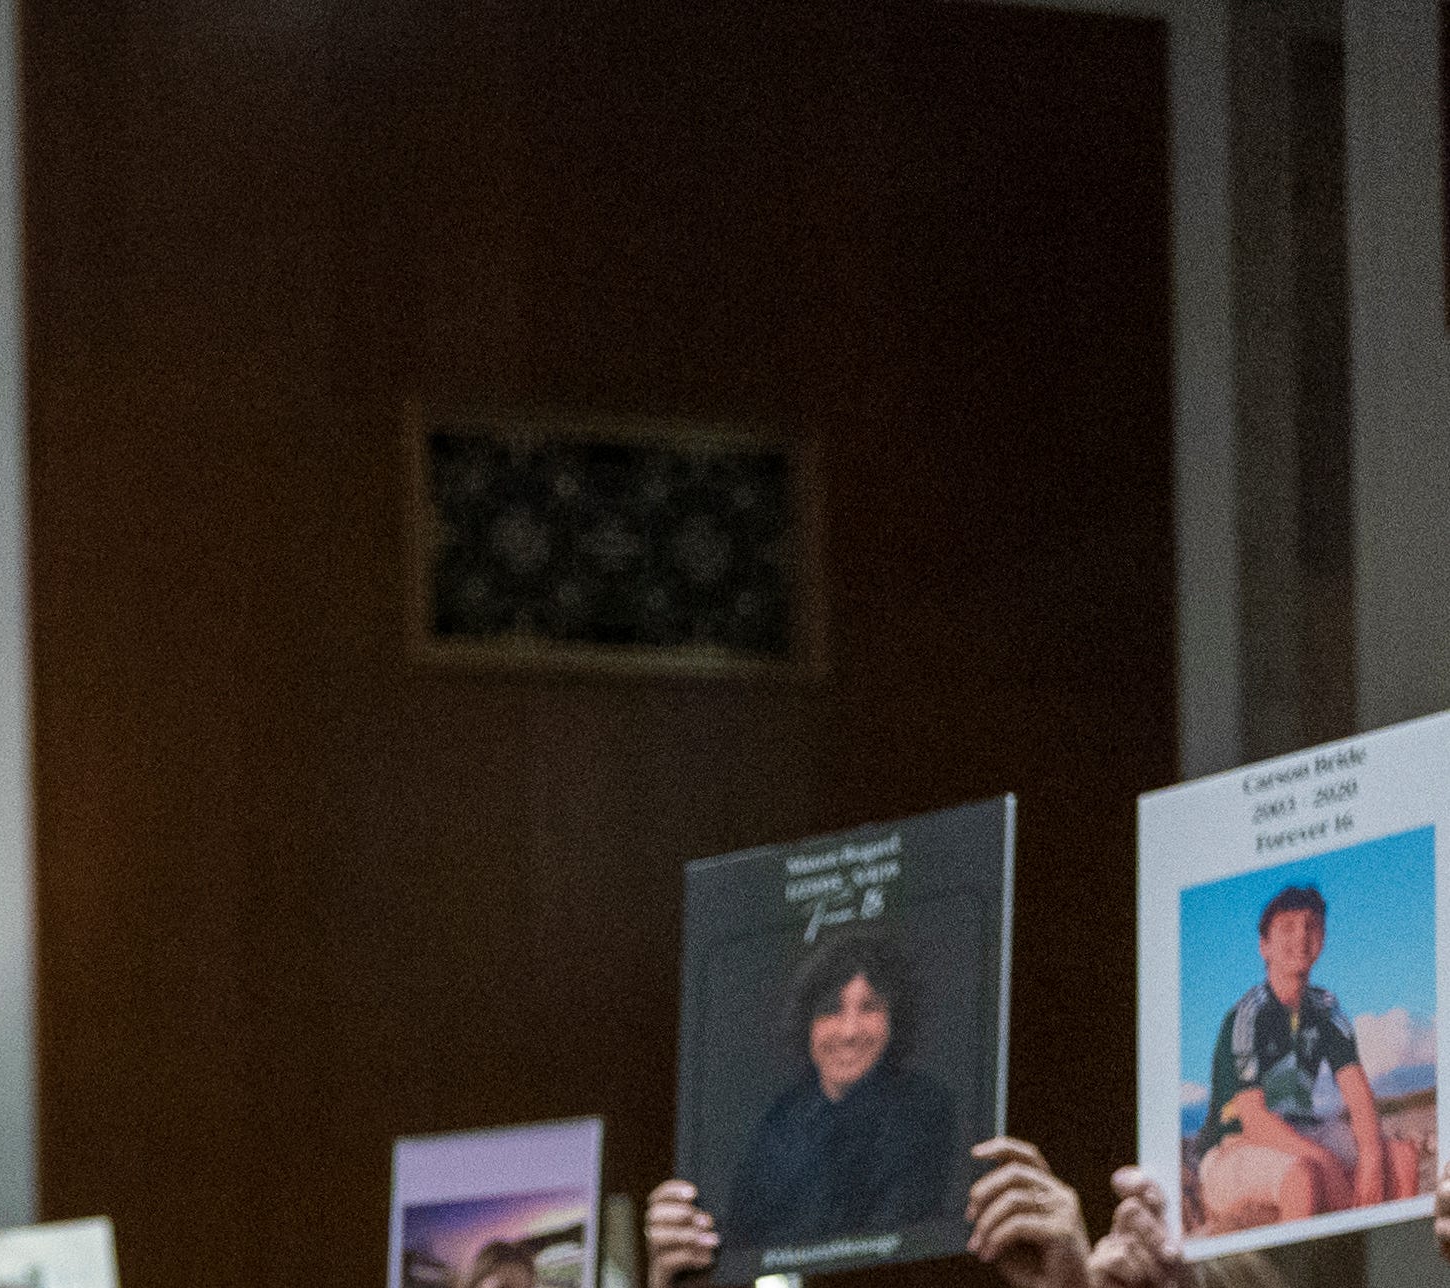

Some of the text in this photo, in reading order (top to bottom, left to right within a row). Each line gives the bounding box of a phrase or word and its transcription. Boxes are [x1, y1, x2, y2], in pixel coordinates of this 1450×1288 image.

[1242, 745, 1368, 796] Carson Bride
[1312, 776, 1358, 809] 2020
[1255, 819, 1328, 853] Forever
